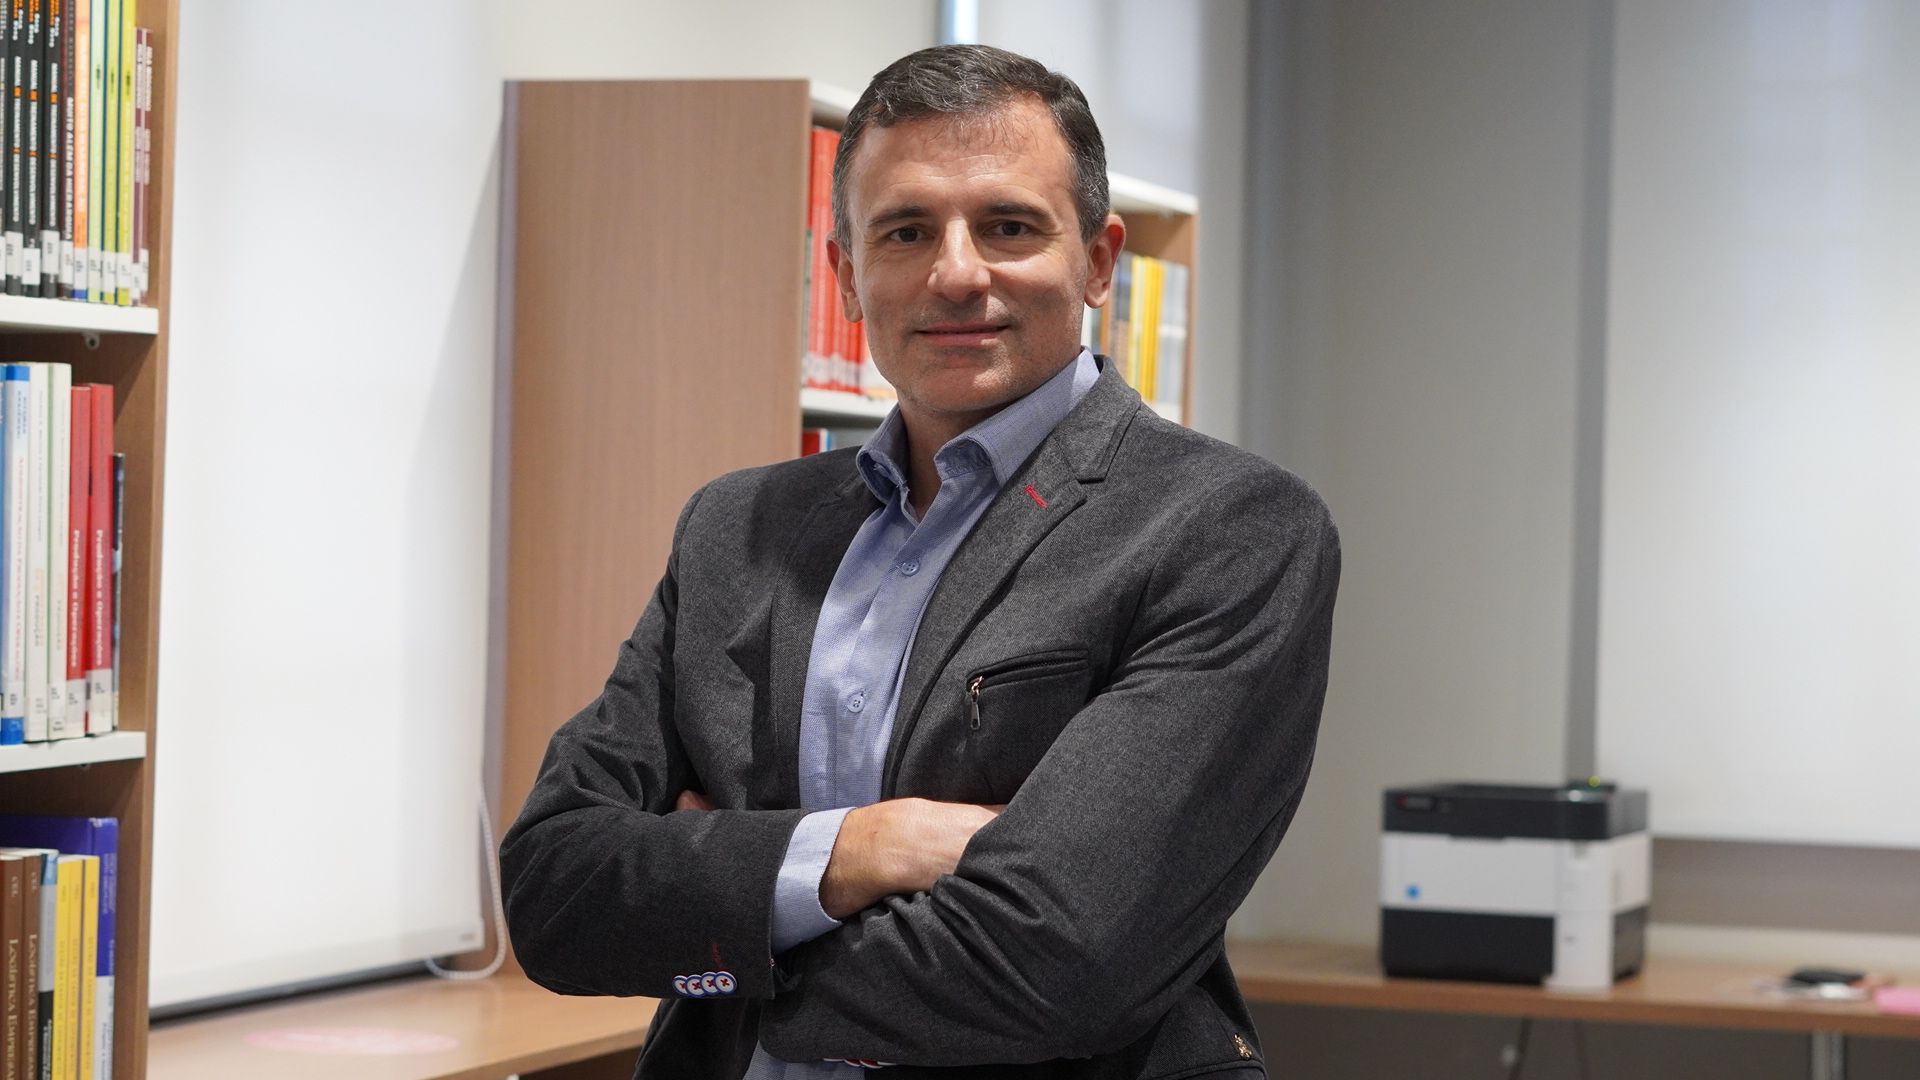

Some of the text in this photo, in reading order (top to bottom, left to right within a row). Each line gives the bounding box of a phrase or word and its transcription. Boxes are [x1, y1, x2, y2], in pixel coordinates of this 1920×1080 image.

[66, 97, 74, 131] MUITO
[65, 162, 73, 177] DA
[71, 529, 81, 589] Produção
[95, 529, 104, 589] Produção
[69, 602, 80, 668] Operações
[94, 601, 104, 666] Operações
